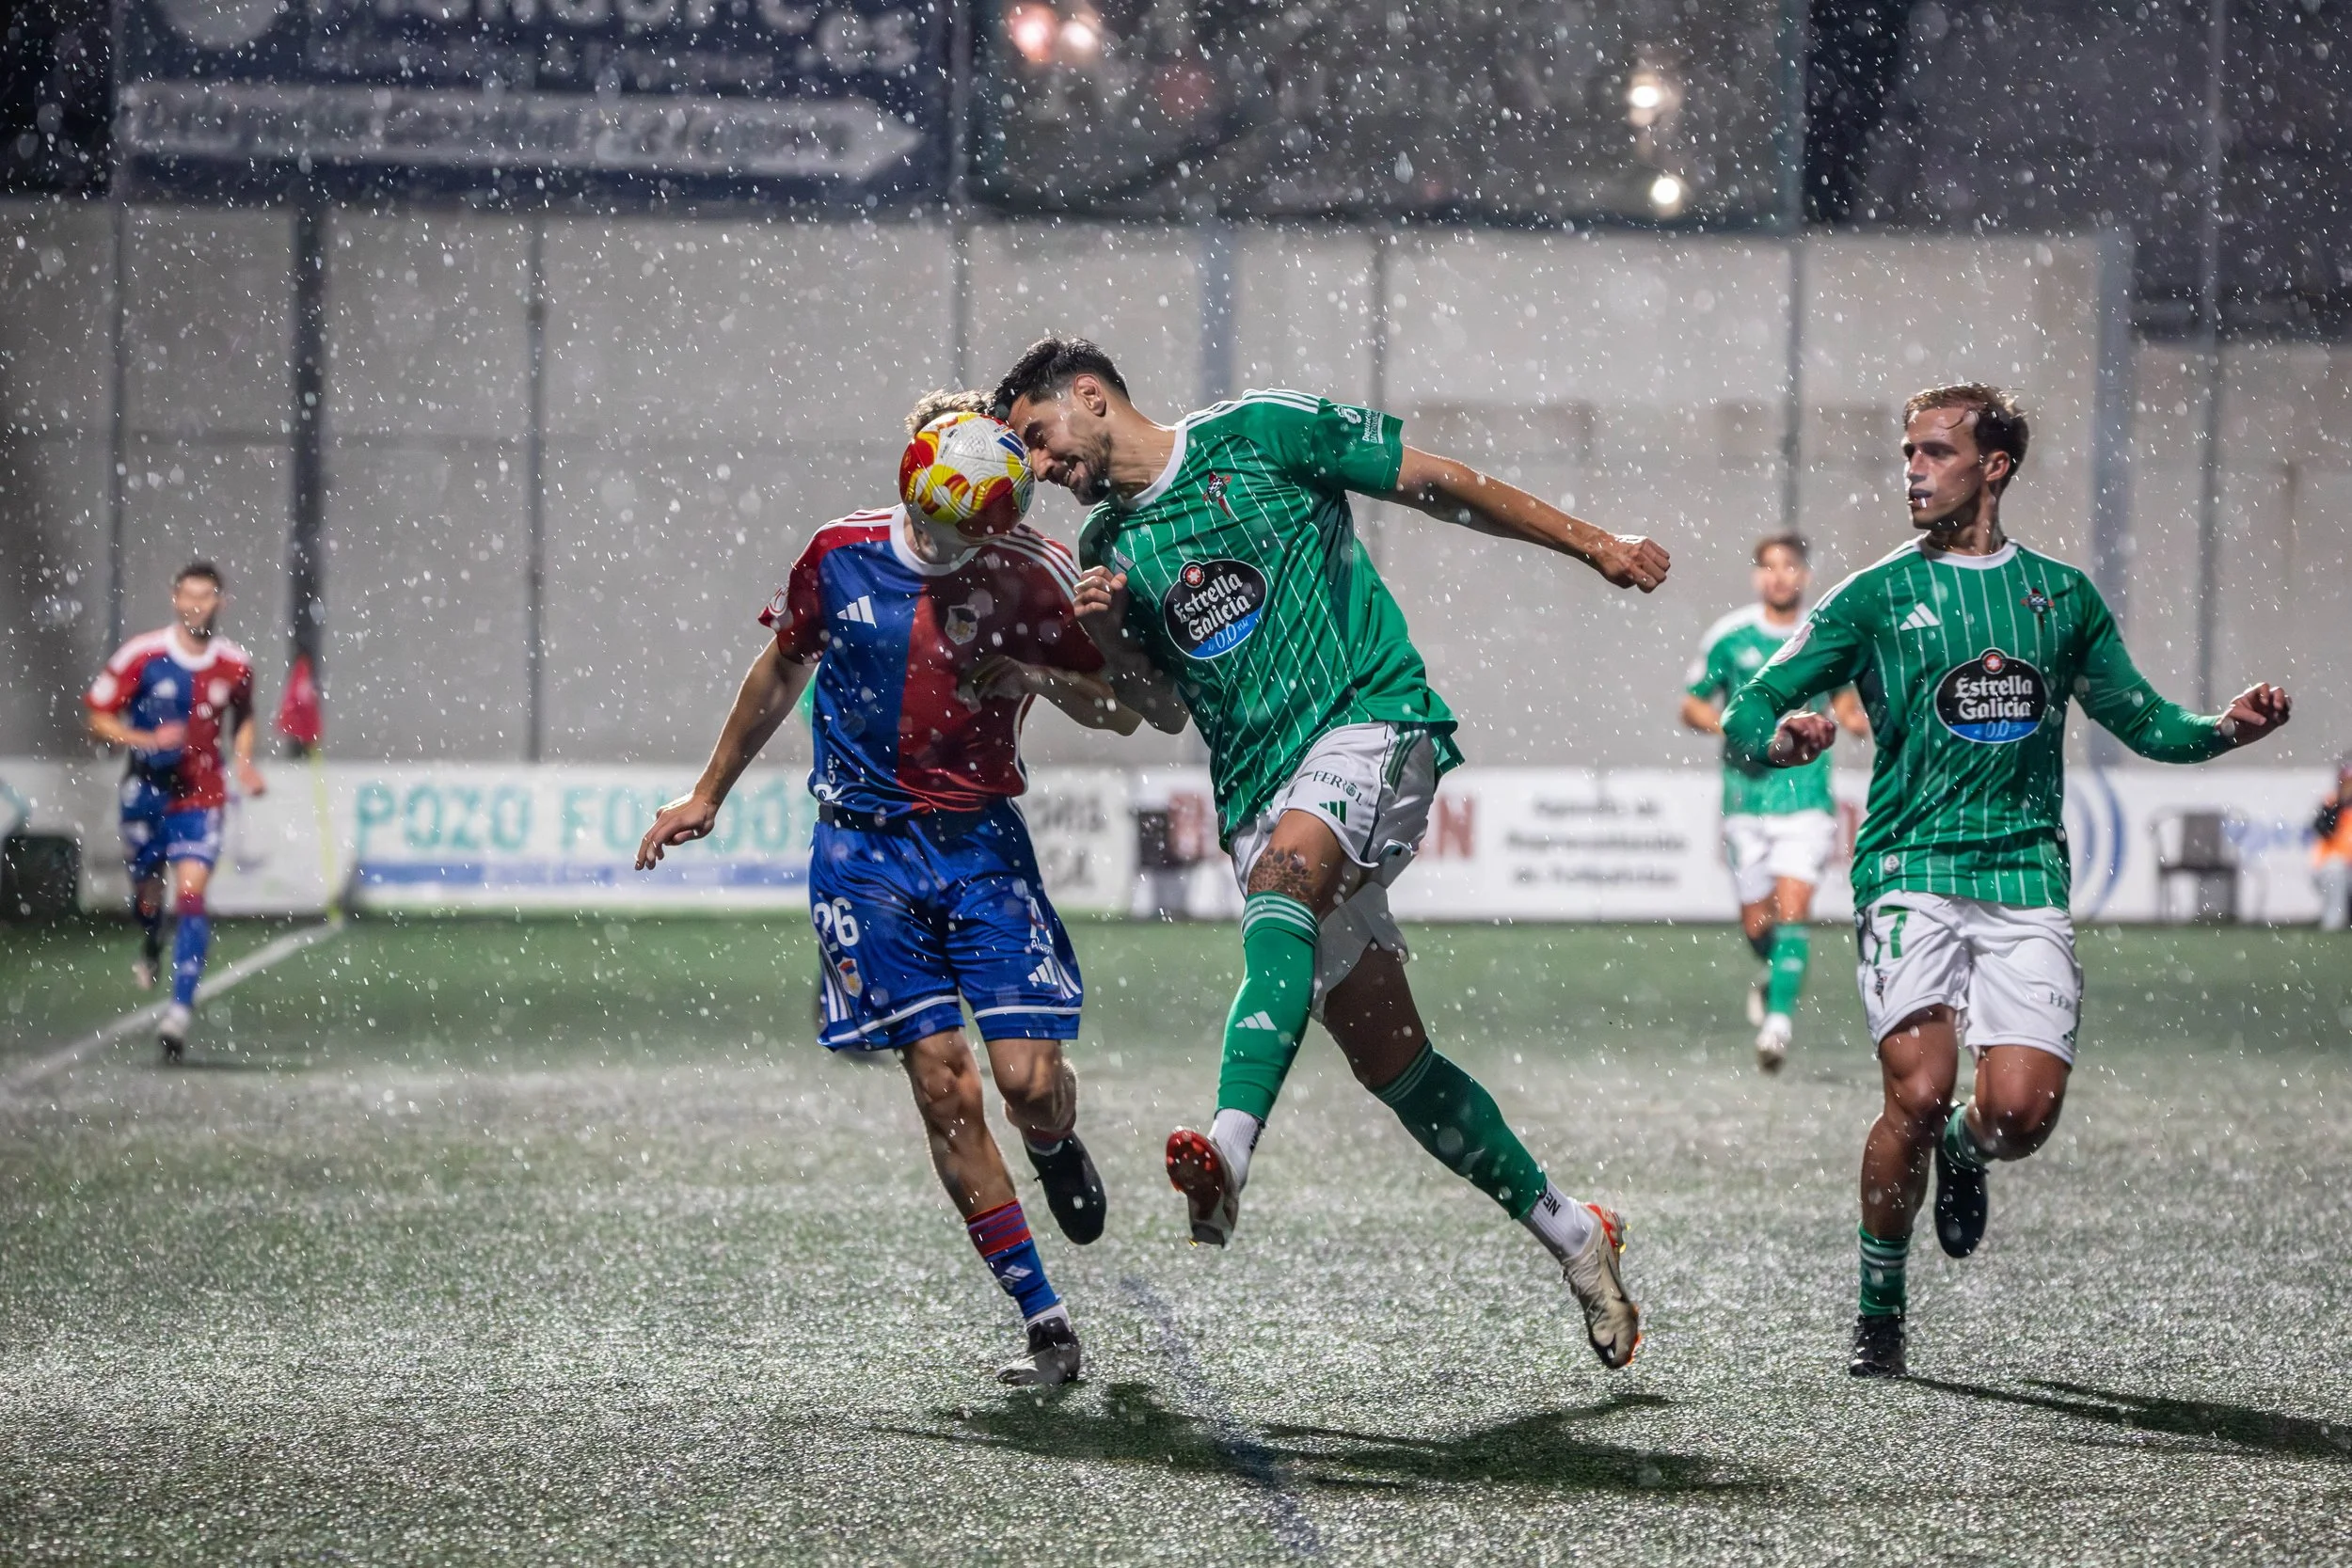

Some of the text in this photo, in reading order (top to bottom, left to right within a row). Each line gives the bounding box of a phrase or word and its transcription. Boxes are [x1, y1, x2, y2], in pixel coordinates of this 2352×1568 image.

[1173, 573, 1244, 624] Estrella
[1188, 594, 1251, 641] Galicia
[1955, 674, 2033, 698] Estrella
[1959, 696, 2032, 721] Galicia
[813, 896, 860, 953] 26
